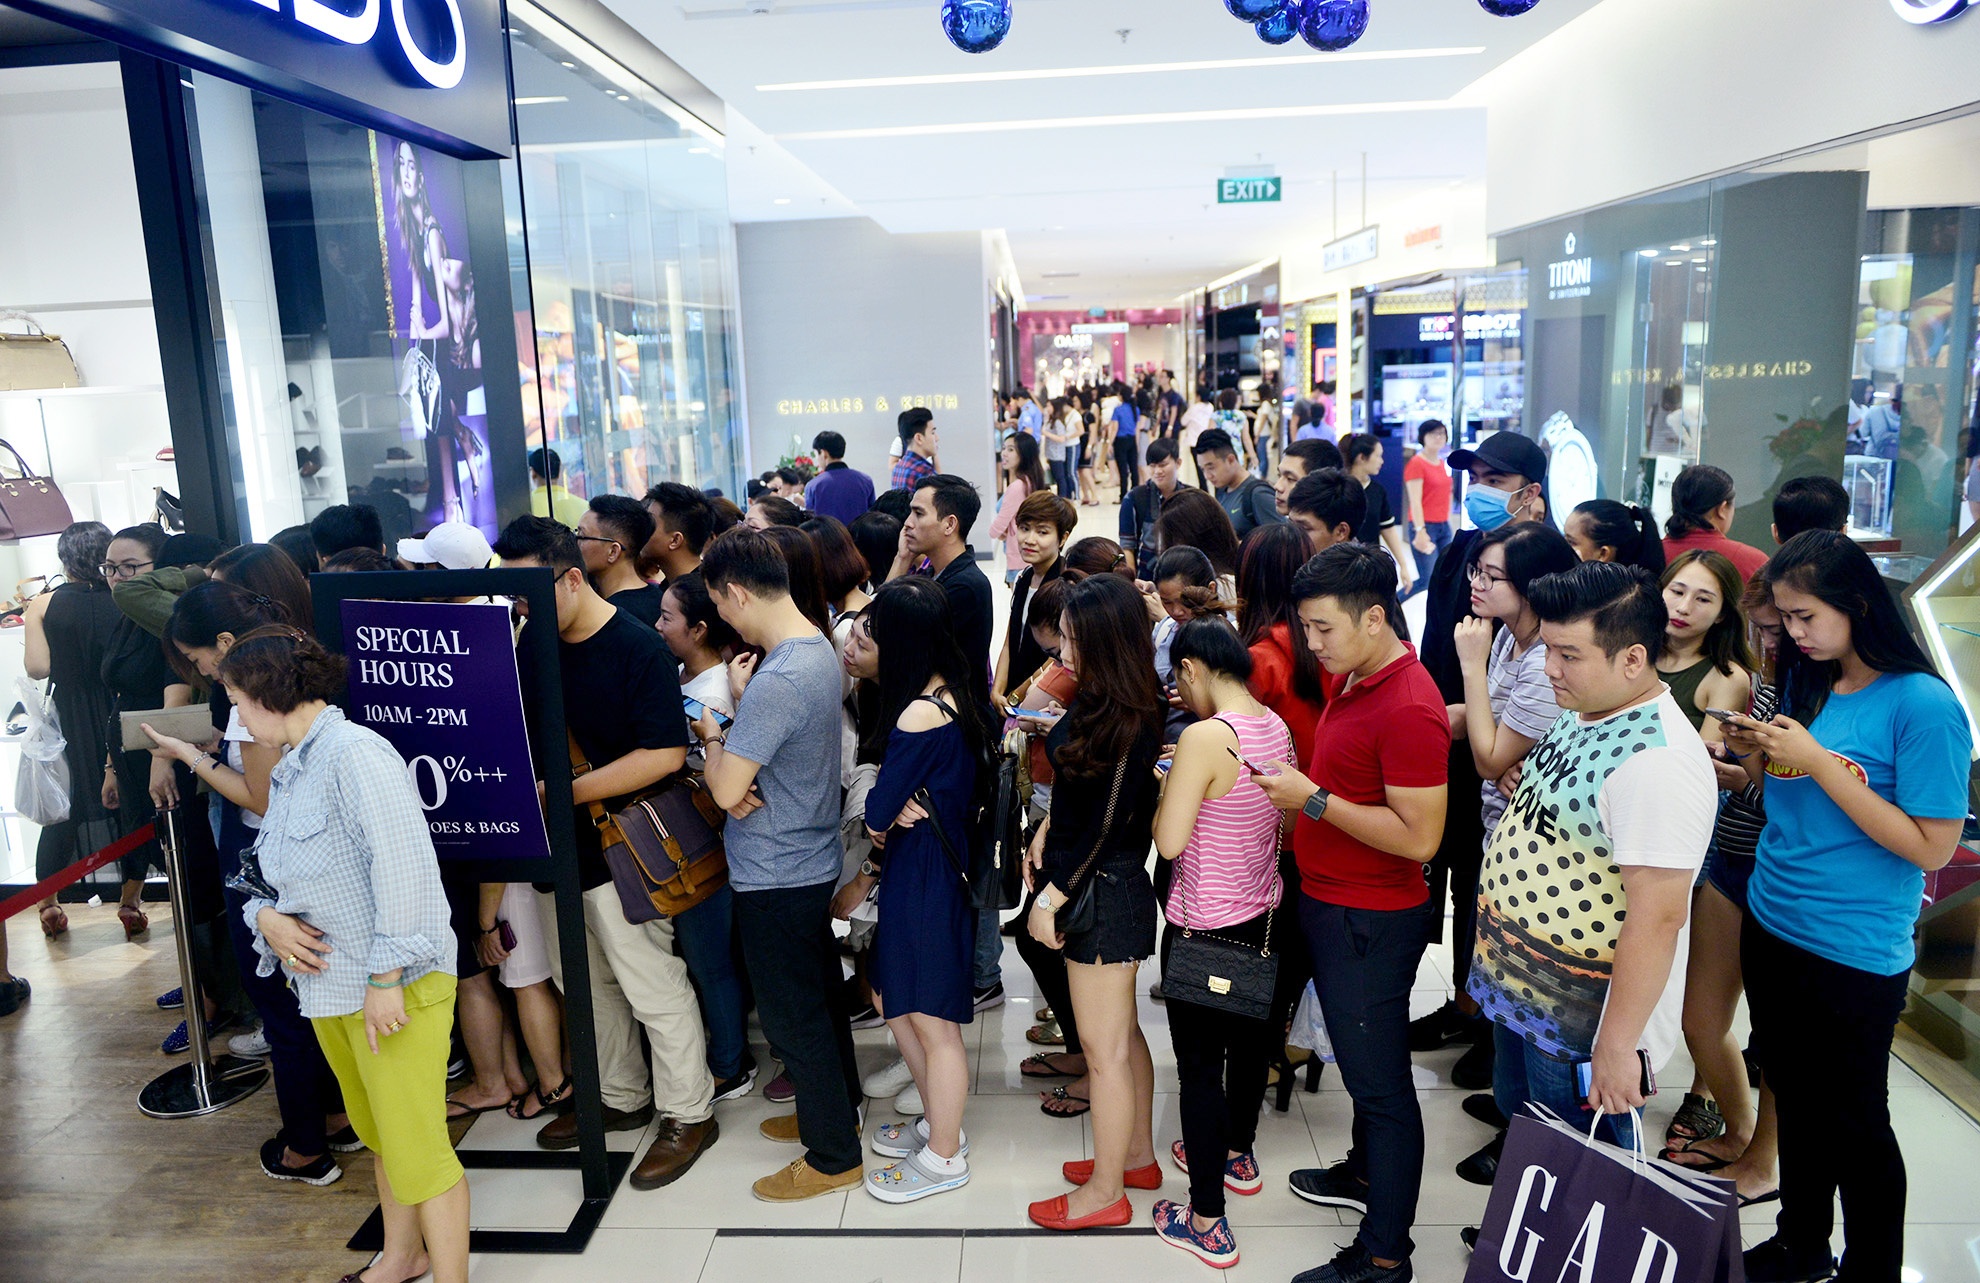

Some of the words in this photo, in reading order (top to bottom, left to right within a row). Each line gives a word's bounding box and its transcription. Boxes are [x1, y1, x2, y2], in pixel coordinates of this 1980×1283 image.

[1223, 180, 1267, 200] EXIT
[1548, 257, 1591, 288] TITONI
[1053, 333, 1093, 348] OASIS
[777, 398, 865, 415] CHARLES
[875, 396, 889, 412] &
[901, 394, 959, 410] KEITH
[356, 625, 470, 655] SPECIAL
[358, 659, 454, 688] HOURS
[407, 754, 508, 811] 0%++
[427, 821, 461, 834] OES
[464, 821, 477, 834] &
[479, 821, 520, 834] BAGS
